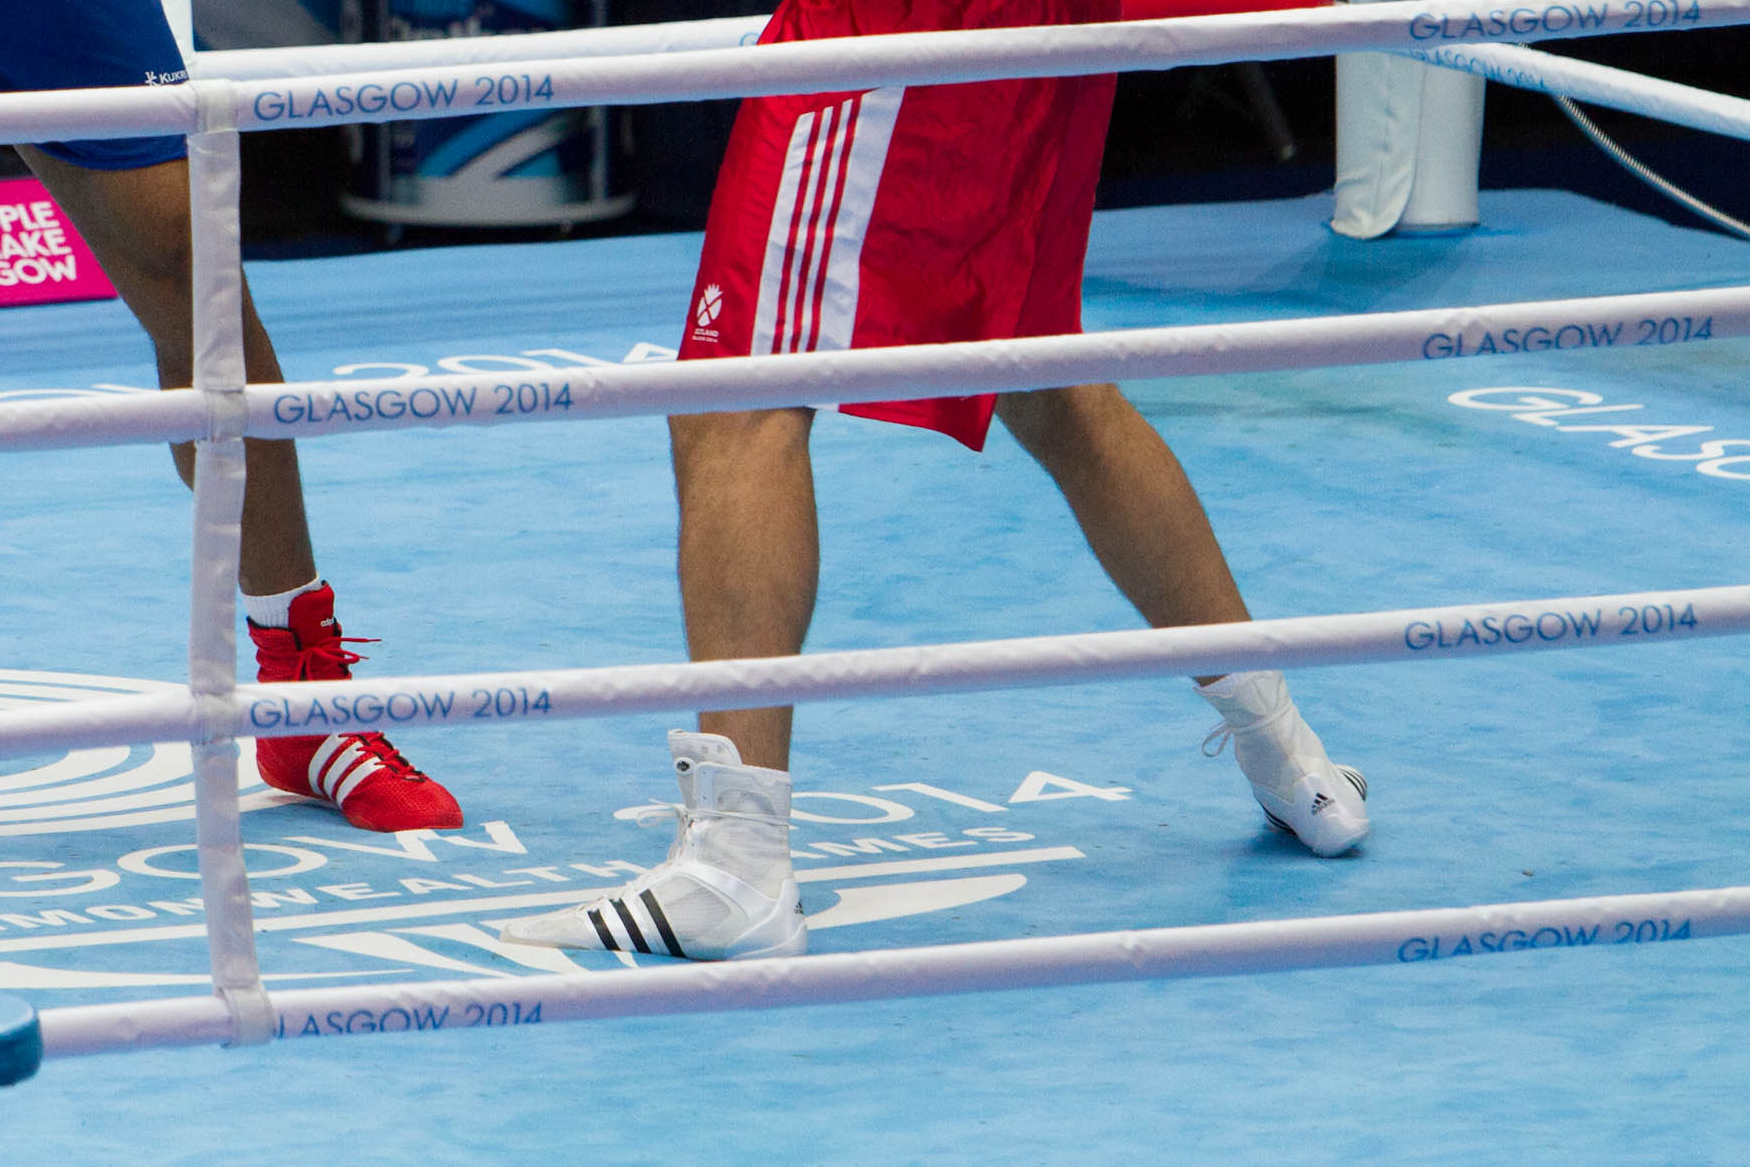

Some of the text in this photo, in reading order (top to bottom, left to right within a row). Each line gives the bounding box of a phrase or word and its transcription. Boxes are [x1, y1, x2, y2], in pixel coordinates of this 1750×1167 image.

[1409, 0, 1702, 40] GLASGOW 2014
[254, 74, 555, 121] GLASGOW 2014
[1423, 316, 1713, 360] GLASGOW 2014
[273, 382, 574, 424] GLASGOW 2014
[1404, 603, 1698, 650] GLASGOW 2014
[250, 687, 552, 729] GLASGOW 2014
[1398, 919, 1691, 963] GLASGOW 2014
[465, 1001, 543, 1028] 2014
